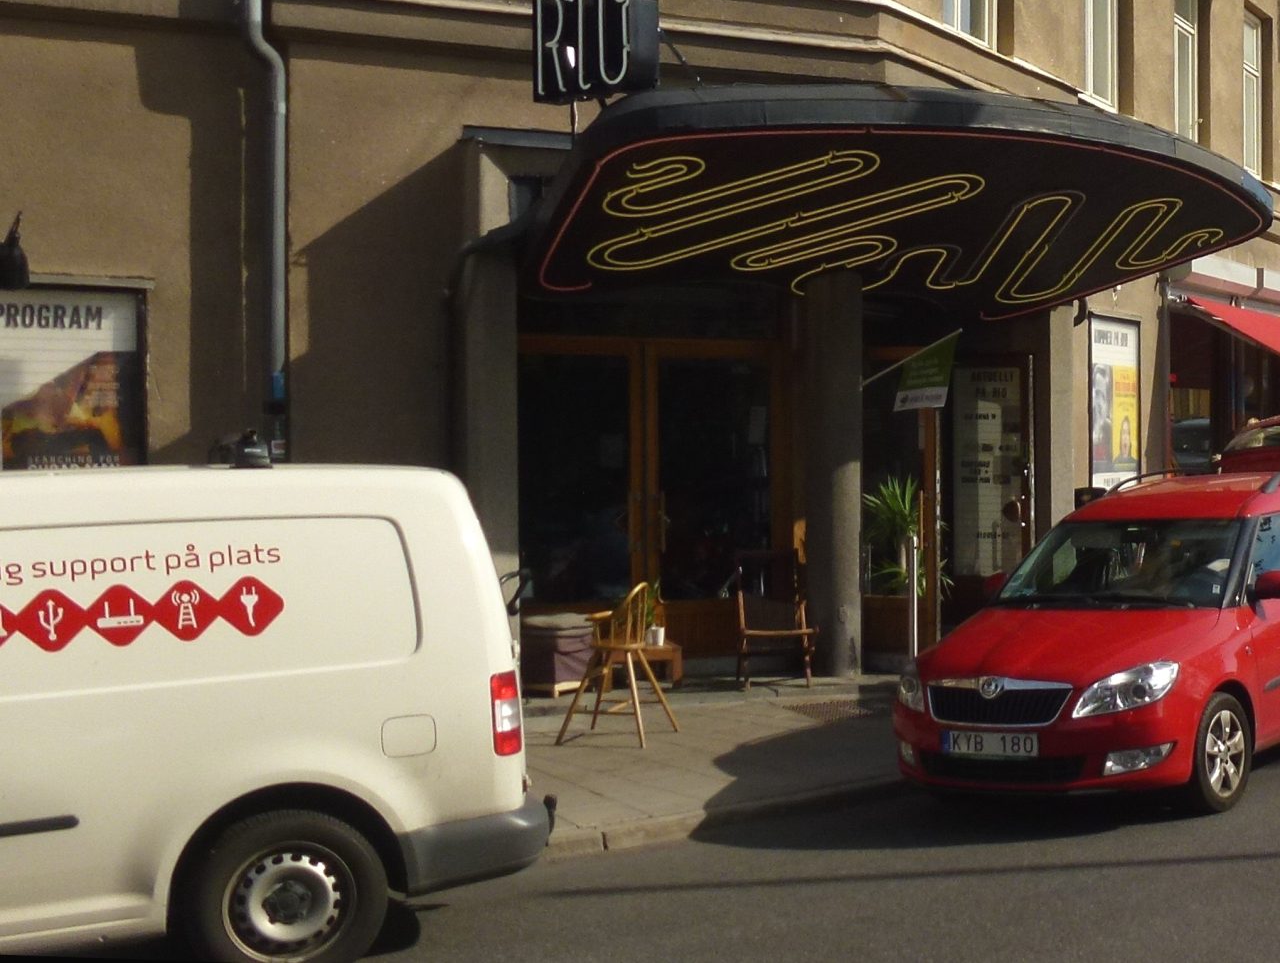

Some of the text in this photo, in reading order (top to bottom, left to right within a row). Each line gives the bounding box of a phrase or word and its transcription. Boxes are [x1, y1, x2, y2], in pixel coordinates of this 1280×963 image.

[31, 549, 156, 582] support
[165, 543, 201, 575] på
[209, 543, 281, 573] plats
[952, 733, 1034, 754] KYB 180
